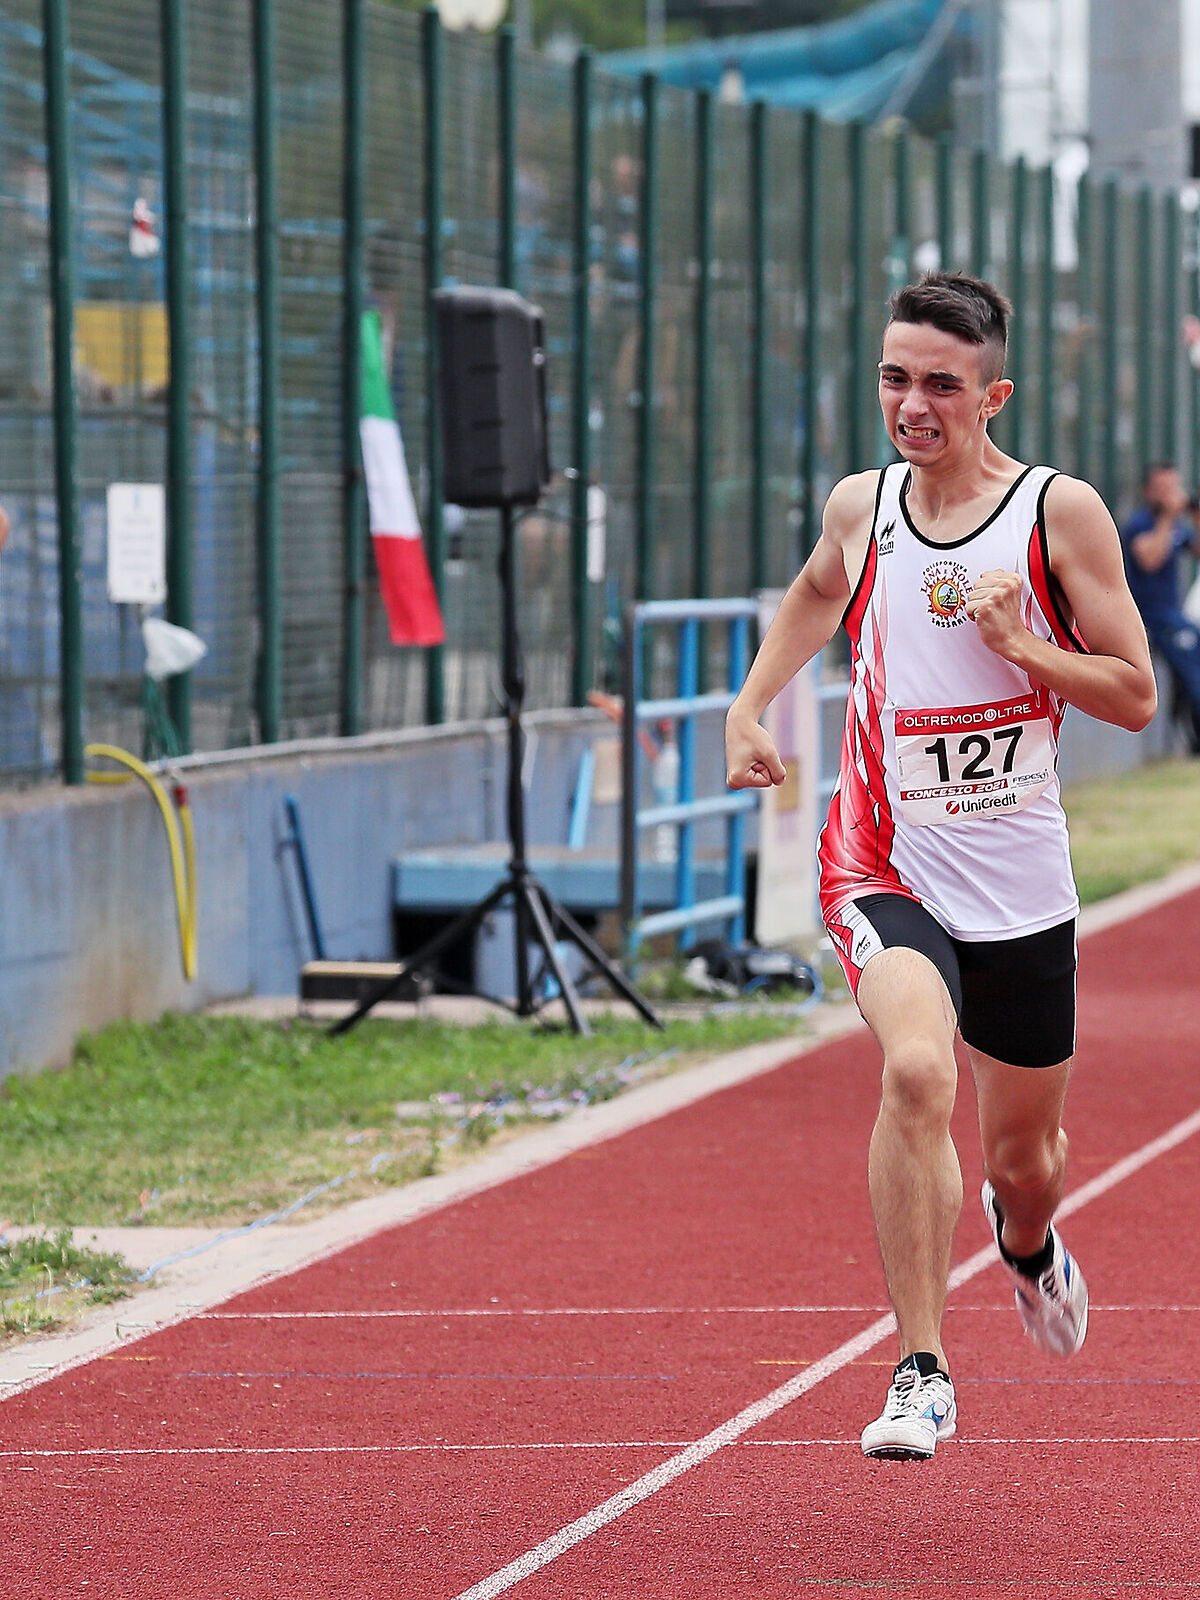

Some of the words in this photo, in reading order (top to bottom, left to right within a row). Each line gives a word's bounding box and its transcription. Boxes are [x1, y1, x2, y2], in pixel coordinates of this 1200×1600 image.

[921, 568, 941, 593] LUNA
[952, 567, 973, 594] SOLE
[932, 616, 967, 628] SASSARI
[925, 726, 1024, 782] 127
[906, 786, 974, 799] CONCESIO
[975, 780, 1006, 793] 2021
[962, 793, 1017, 812] UniCredit
